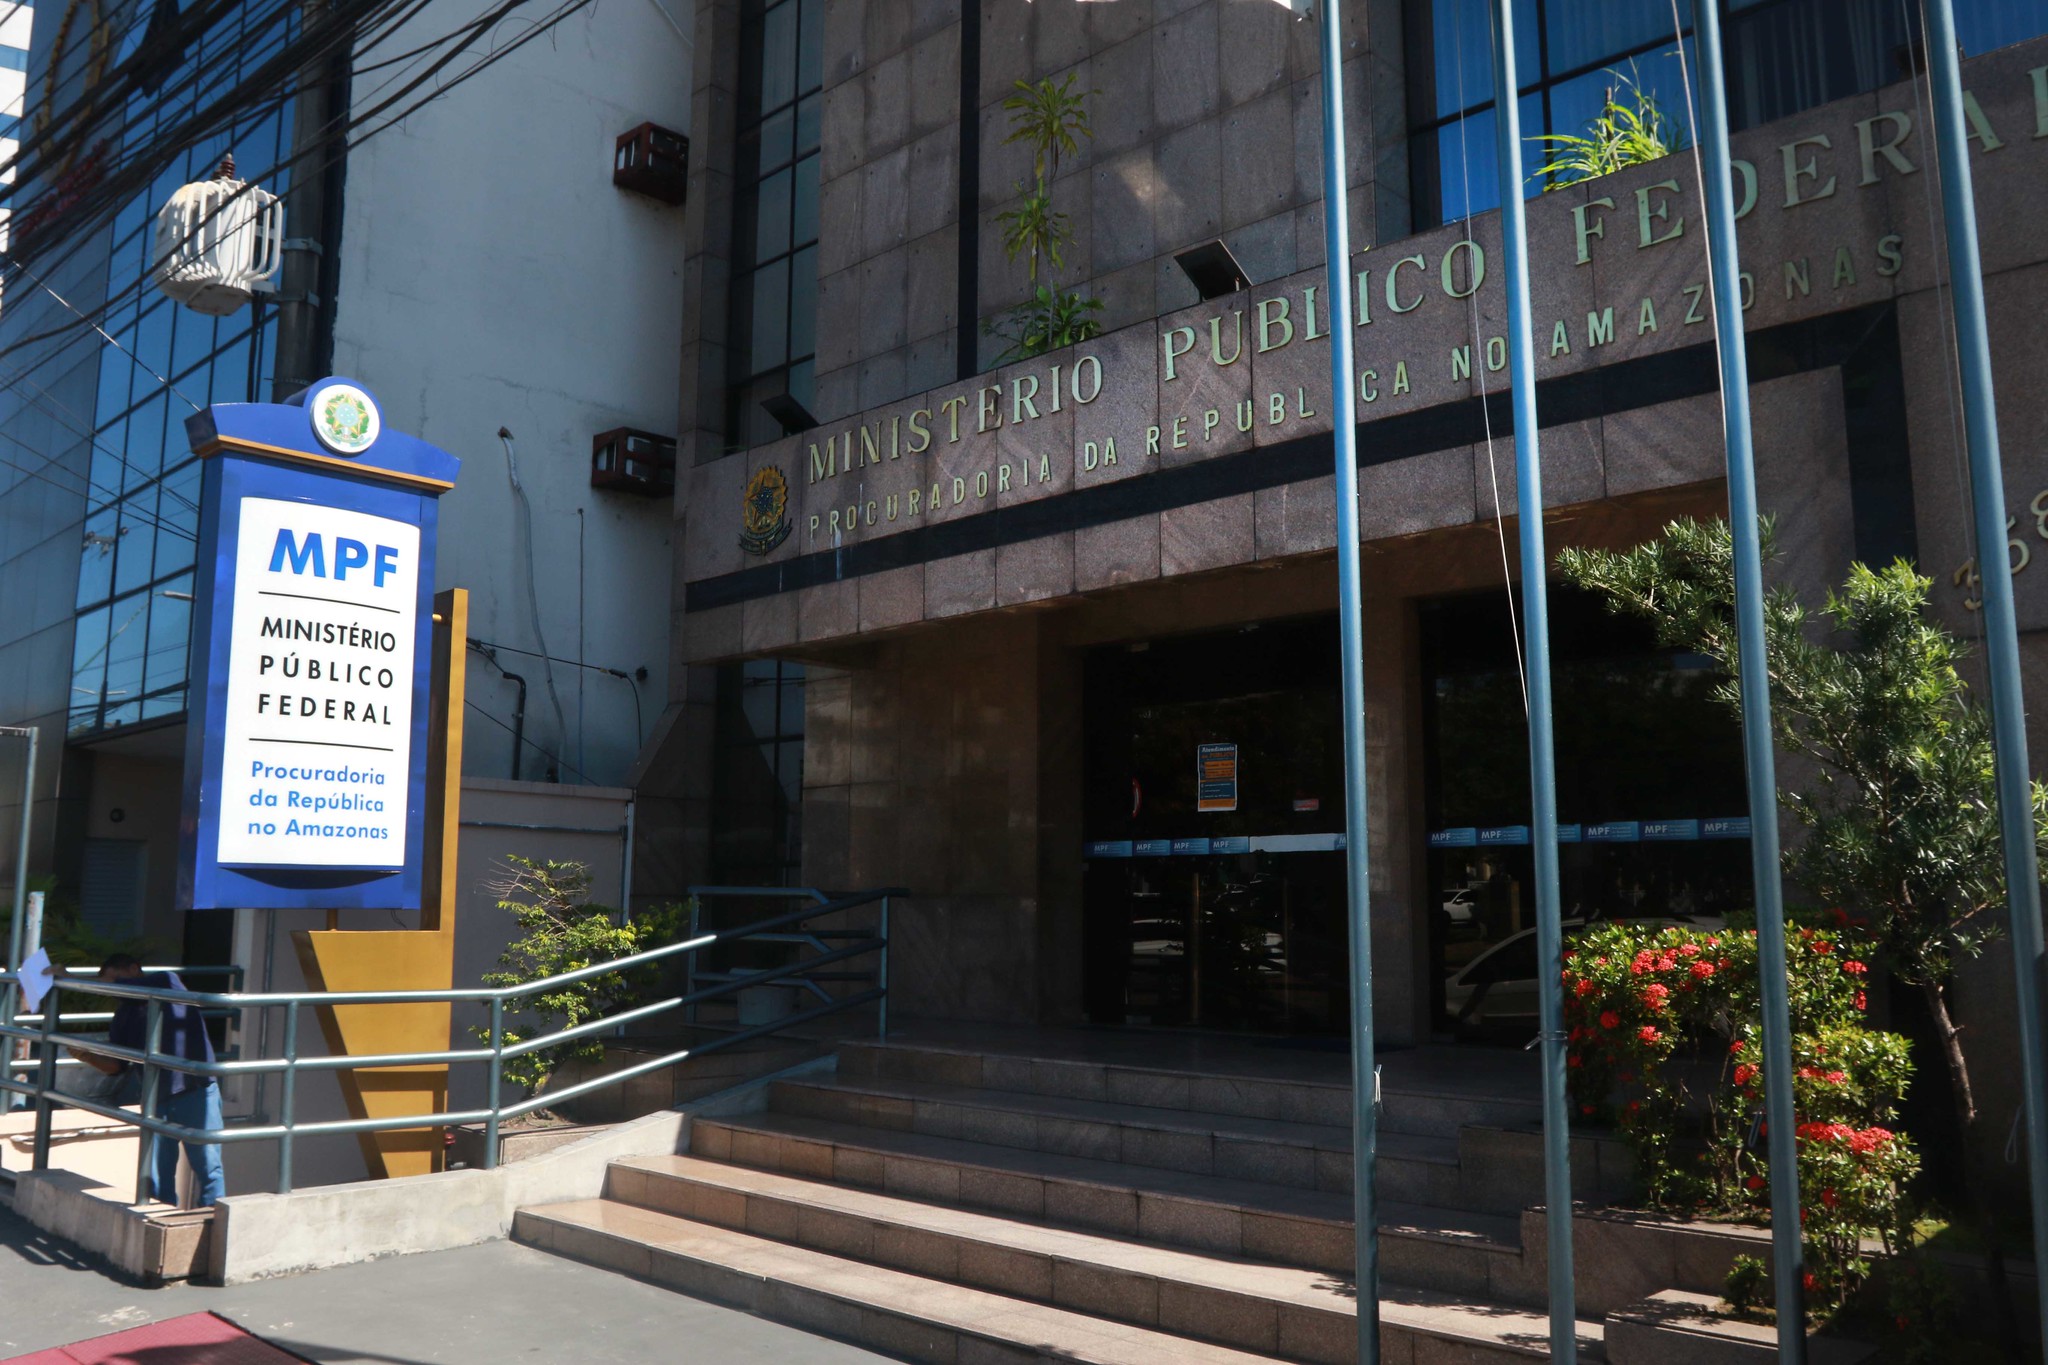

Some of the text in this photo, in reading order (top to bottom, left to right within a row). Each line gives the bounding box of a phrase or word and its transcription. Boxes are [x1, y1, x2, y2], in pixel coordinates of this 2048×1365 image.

[808, 355, 1103, 485] MINISTERIO
[1163, 240, 1486, 382] PUBLICO
[811, 454, 1052, 538] PROCURADORIA
[1085, 437, 1118, 472] DA
[1146, 361, 1410, 455] REPUBLCA
[1452, 336, 1507, 382] NO
[268, 528, 399, 588] MPF
[260, 616, 396, 652] MINISTÉRIO
[259, 652, 394, 688] PÚBLICO
[258, 693, 391, 725] FEDERAL
[251, 761, 385, 785] Procuradoria
[249, 789, 384, 813] da República
[248, 819, 388, 840] no Amazonas
[1431, 832, 1452, 841] MPF
[1481, 830, 1502, 839] MPF
[1588, 826, 1611, 836] MPF
[1644, 824, 1668, 834] MPF
[1704, 822, 1728, 832] MPF
[1137, 843, 1152, 851] MPF
[1174, 842, 1190, 850] MPF
[1213, 840, 1229, 848] MPF
